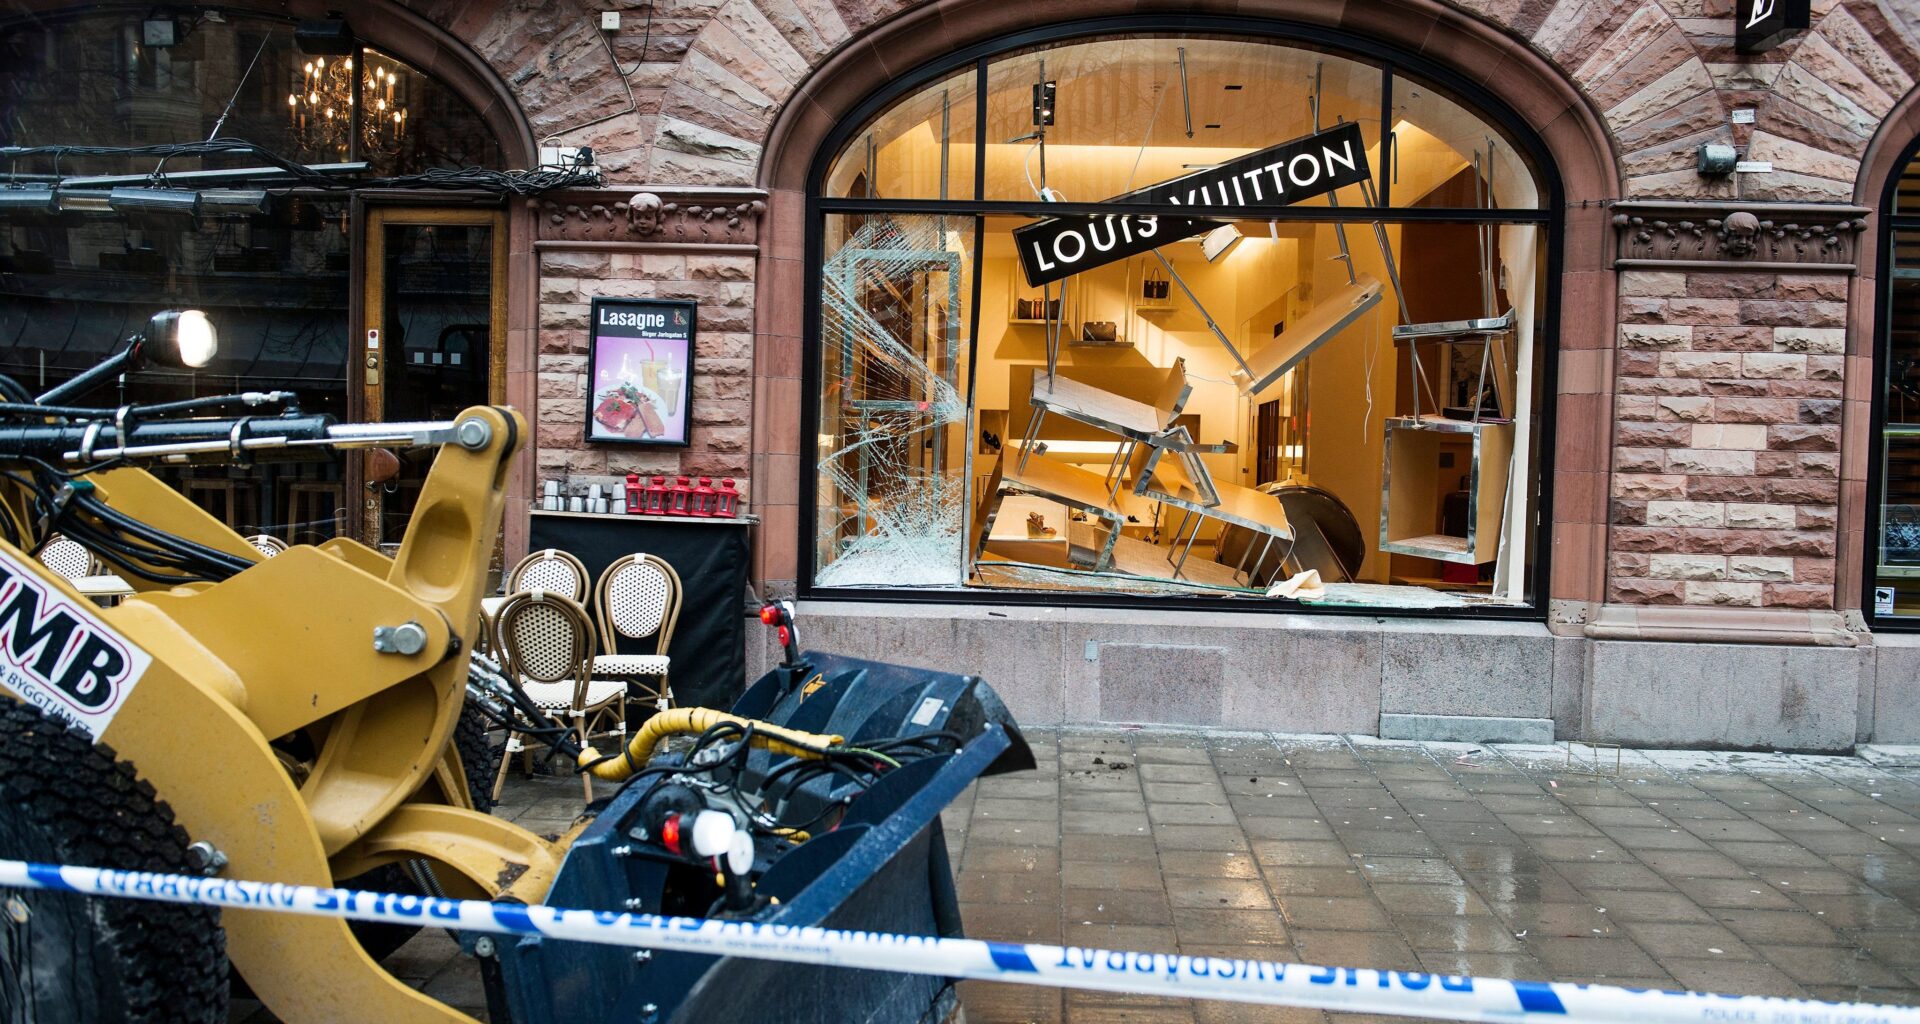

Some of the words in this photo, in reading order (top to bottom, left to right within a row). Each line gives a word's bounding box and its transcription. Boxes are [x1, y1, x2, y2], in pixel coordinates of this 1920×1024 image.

[1033, 216, 1158, 272] LOUIS
[1169, 140, 1356, 225] VUITTON
[600, 308, 665, 330] Lasagne
[642, 330, 657, 338] Birger
[0, 566, 125, 708] MB
